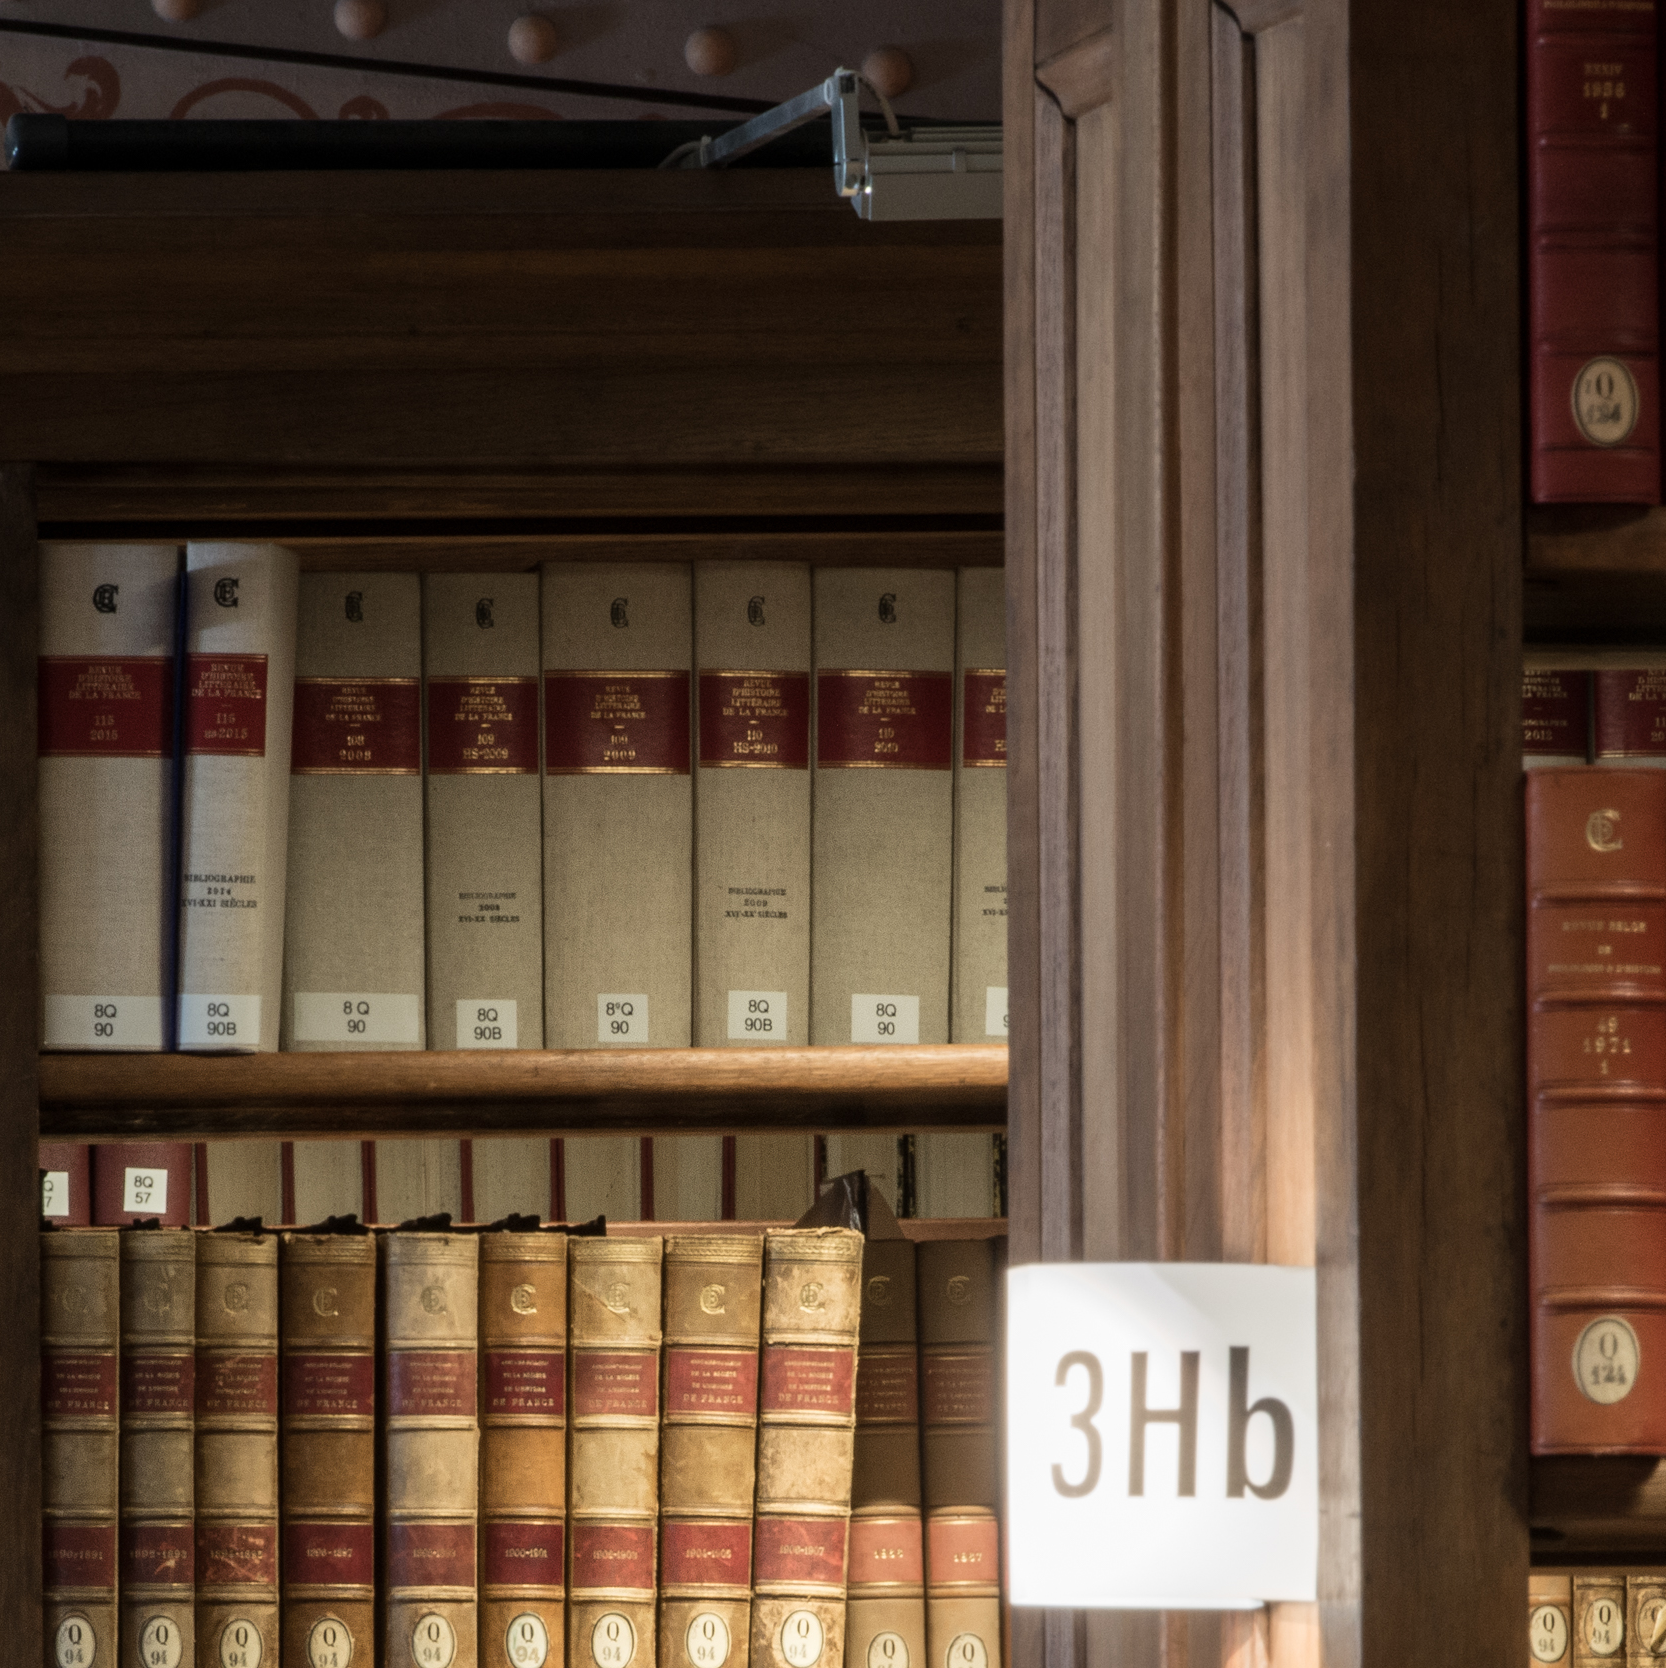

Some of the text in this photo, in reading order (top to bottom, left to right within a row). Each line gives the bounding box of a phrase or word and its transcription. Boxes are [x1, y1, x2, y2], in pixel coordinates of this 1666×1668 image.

[95, 1004, 116, 1018] 8Q
[208, 1003, 229, 1017] 8Q
[749, 1000, 769, 1013] 8Q
[876, 1004, 896, 1017] 8Q
[477, 1009, 498, 1021] 8Q
[95, 1023, 113, 1036] 90
[208, 1022, 236, 1035] 90B
[348, 1020, 365, 1032] 90
[611, 1021, 629, 1034] 90
[745, 1018, 772, 1031] 90B
[878, 1022, 894, 1034] 90
[474, 1027, 501, 1039] 90B
[134, 1176, 153, 1188] 8Q
[135, 1192, 151, 1204] 57
[1056, 1345, 1294, 1500] 3Hb
